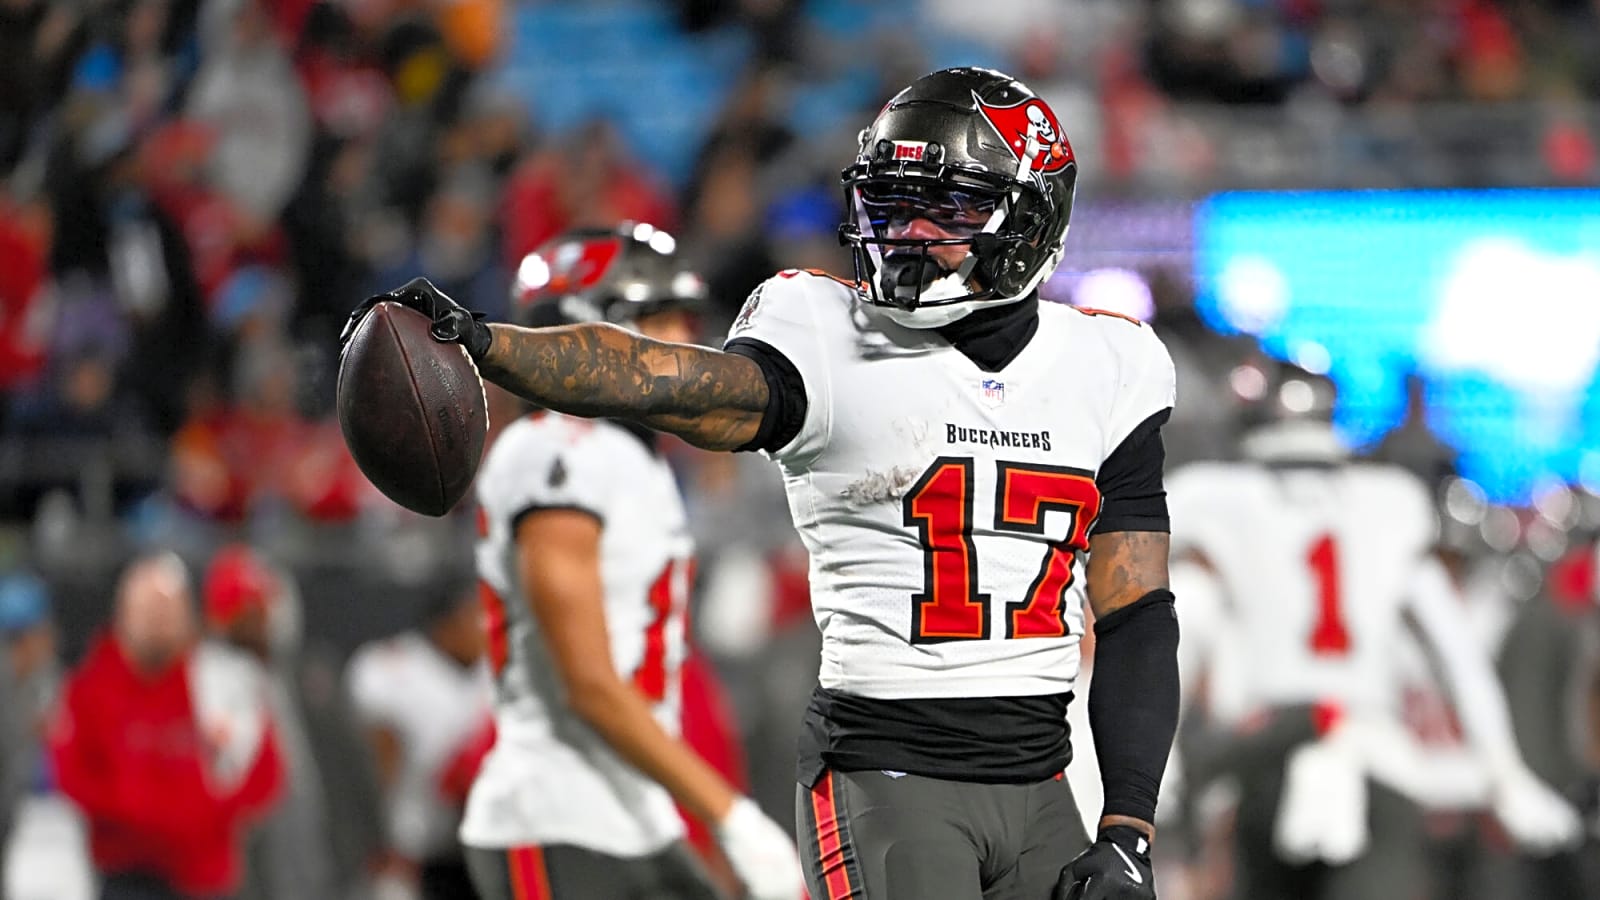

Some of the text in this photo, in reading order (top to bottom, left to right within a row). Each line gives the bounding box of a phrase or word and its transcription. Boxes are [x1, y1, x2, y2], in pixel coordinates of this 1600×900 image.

[945, 423, 1051, 452] BUCCANEERS
[902, 456, 1101, 645] 17
[1303, 529, 1354, 657] 1
